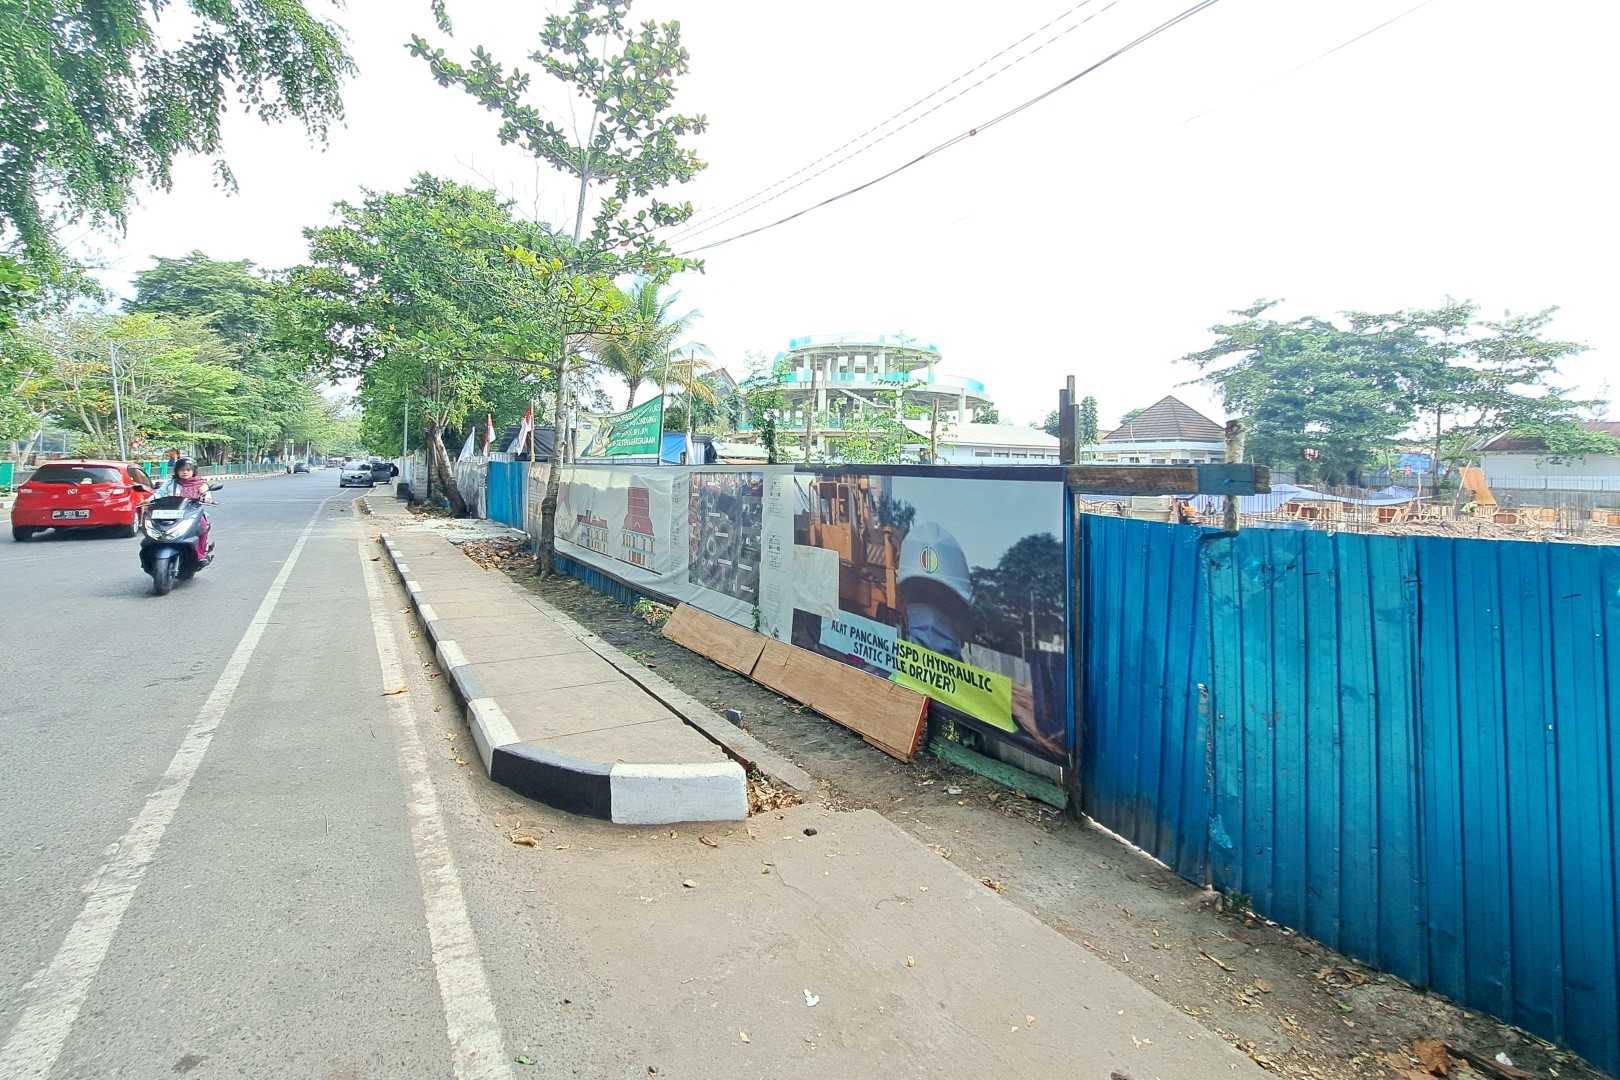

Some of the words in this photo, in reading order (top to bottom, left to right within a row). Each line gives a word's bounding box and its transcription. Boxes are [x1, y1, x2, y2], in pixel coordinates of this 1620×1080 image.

[831, 620, 847, 636] ALAT
[850, 626, 889, 652] PANCANG
[892, 642, 919, 663] HSPD
[922, 652, 993, 693] (HYDRAULIC
[853, 642, 883, 664] STATIC
[885, 653, 907, 675] PILE
[909, 664, 956, 694] DRIVER)
